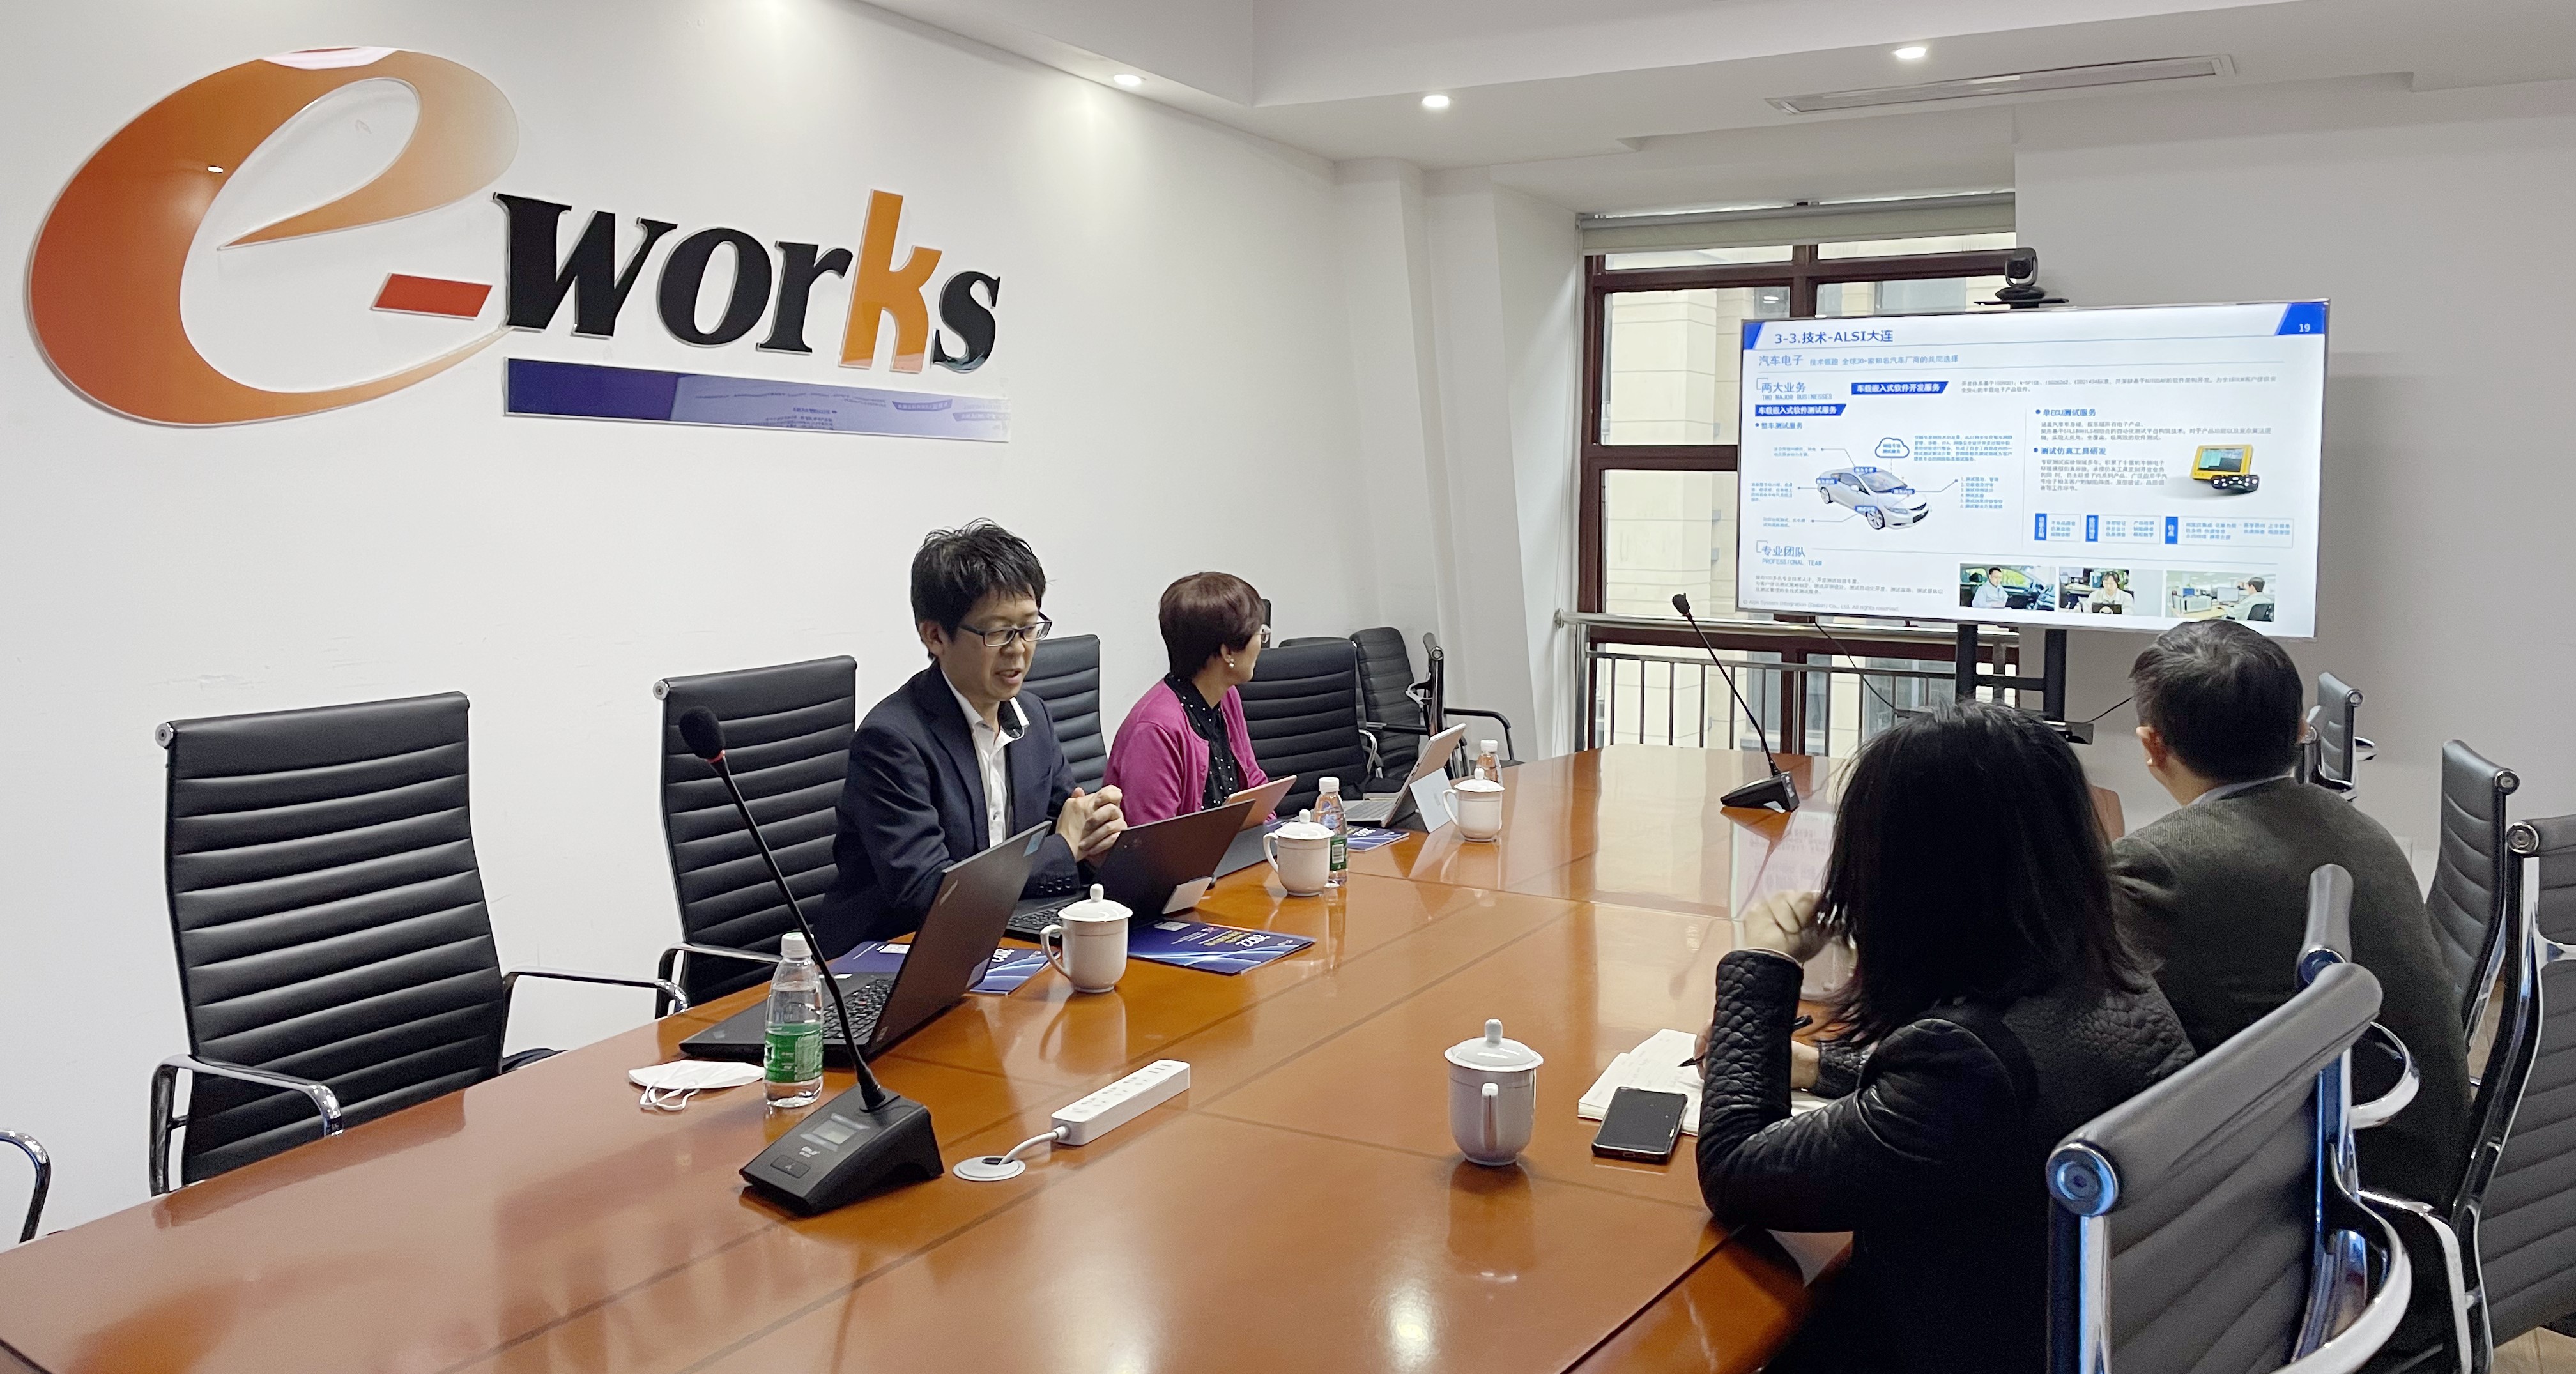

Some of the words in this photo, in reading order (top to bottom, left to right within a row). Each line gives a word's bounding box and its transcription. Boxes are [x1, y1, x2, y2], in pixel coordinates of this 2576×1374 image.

[23, 46, 1001, 427] e-works
[2299, 324, 2311, 333] 19
[1774, 329, 1893, 344] 3-3.技术-ALSI大连
[1758, 355, 1804, 367] 汽车电子
[1761, 381, 1806, 393] 两大业务
[2041, 447, 2106, 455] 测试仿真工具研发
[1761, 545, 1806, 558] 专业团队
[1761, 558, 1804, 566] PROFESSIONAL
